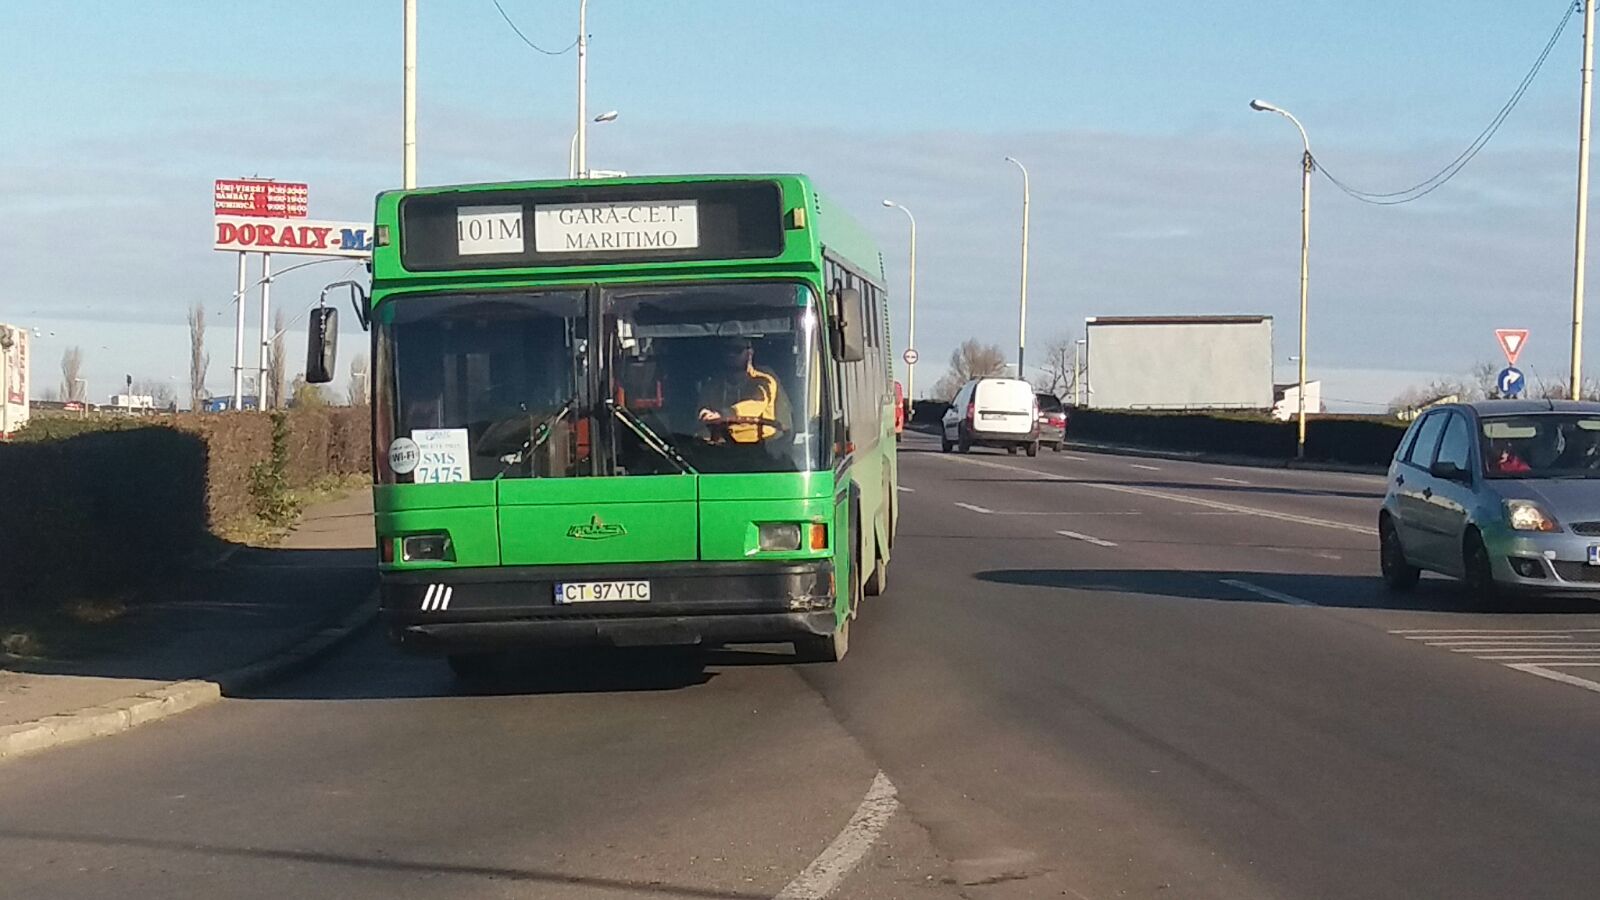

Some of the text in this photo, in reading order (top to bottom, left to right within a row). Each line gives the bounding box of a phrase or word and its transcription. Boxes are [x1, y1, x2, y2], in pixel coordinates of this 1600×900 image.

[458, 218, 522, 242] 101M
[566, 231, 678, 249] MARITIMO
[423, 453, 456, 465] SMS
[420, 467, 463, 482] 7475
[565, 583, 648, 600] CT 97 YTC
